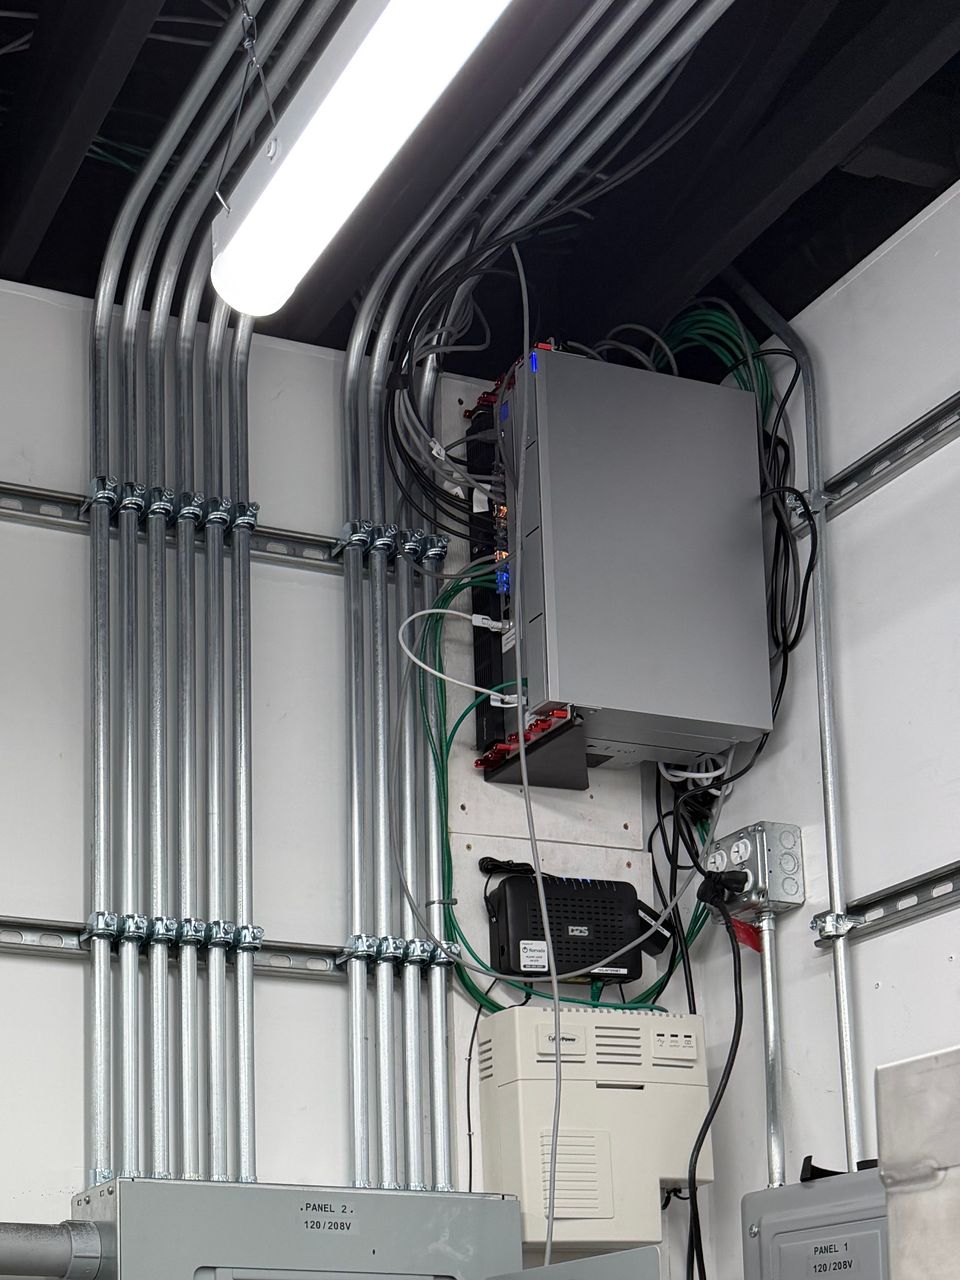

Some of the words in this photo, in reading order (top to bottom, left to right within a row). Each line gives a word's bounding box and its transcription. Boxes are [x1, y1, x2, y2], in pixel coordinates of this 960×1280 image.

[306, 1203, 335, 1213] PANEL
[341, 1205, 347, 1213] 2
[304, 1221, 351, 1231] 120/208V
[814, 1244, 839, 1255] PANEL
[844, 1242, 848, 1251] 1
[813, 1260, 853, 1273] 120/208V
